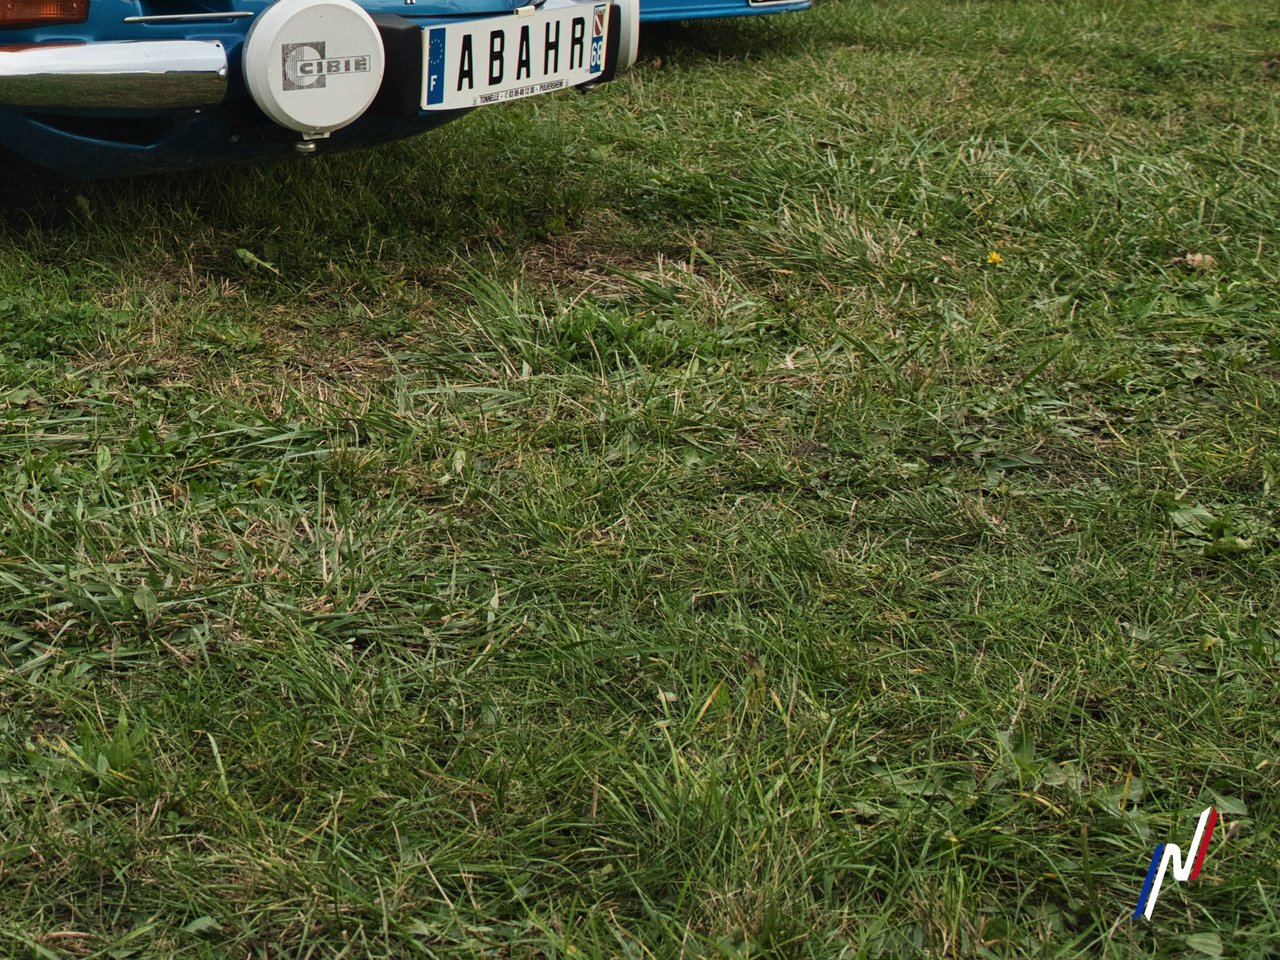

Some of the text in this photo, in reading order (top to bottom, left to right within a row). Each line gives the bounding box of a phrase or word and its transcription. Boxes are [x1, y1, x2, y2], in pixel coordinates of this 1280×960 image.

[430, 16, 603, 92] F ABAHR 68
